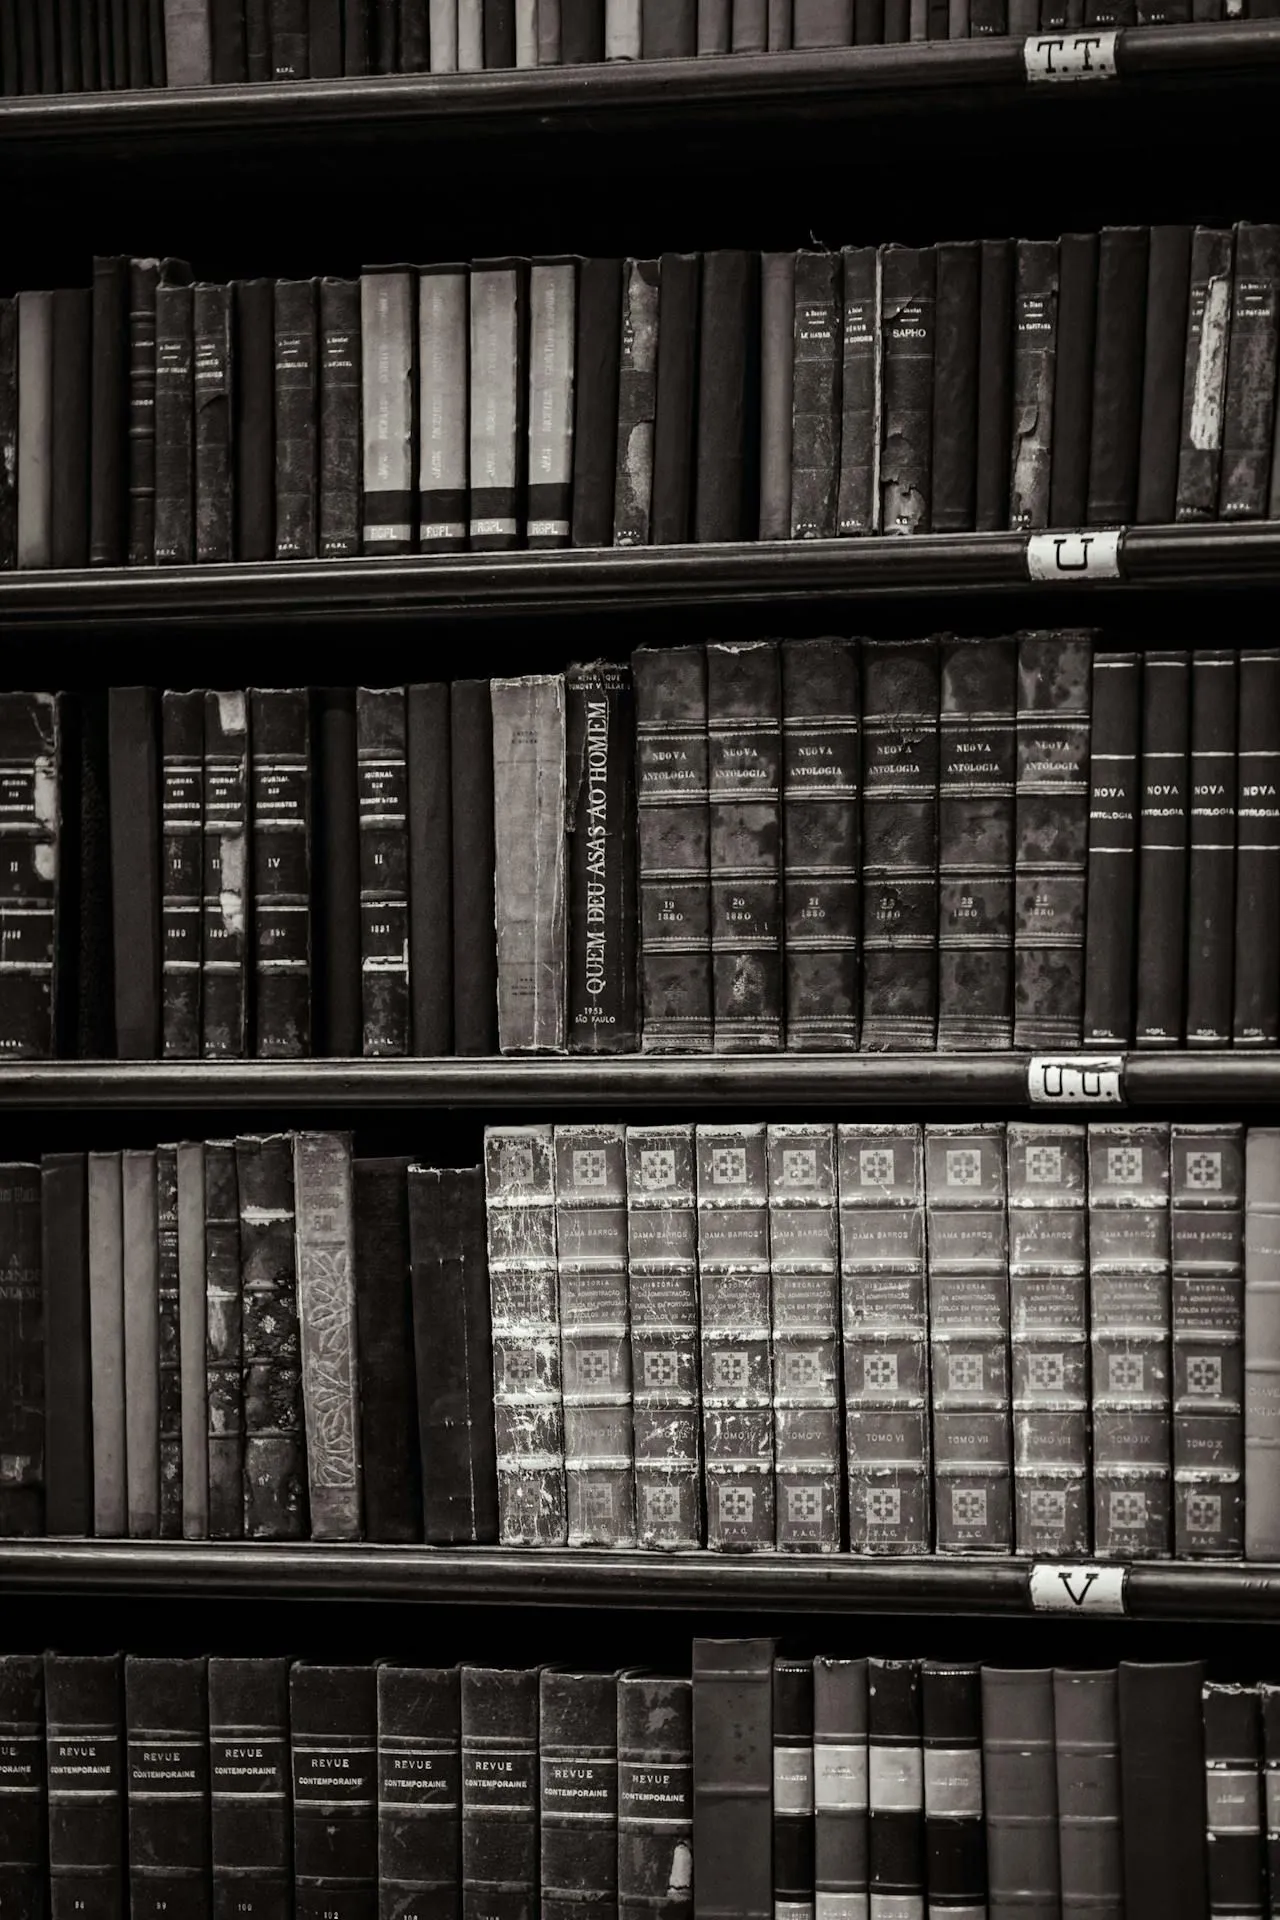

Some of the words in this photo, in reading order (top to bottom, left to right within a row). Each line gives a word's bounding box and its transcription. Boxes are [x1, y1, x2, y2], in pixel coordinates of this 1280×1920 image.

[1037, 38, 1106, 73] T.T.
[892, 328, 926, 338] SAPHO
[1054, 538, 1094, 570] U
[587, 701, 607, 783] HOMEM
[1034, 740, 1070, 751] NUOVA
[798, 747, 833, 756] NUOVA
[957, 743, 991, 753] NUOVA
[653, 751, 687, 761] NUOVA
[723, 749, 757, 758] NUOVA
[869, 765, 920, 775] ANTOLOGIA
[948, 763, 1000, 772] ANTOLOGIA
[1024, 761, 1079, 771] ANTOLOGIA
[643, 770, 695, 781] ANTOLOGIA
[715, 769, 767, 778] ANTOLOGIA
[790, 767, 842, 776] ANTOLOGIA
[1094, 788, 1125, 797] NOVA
[1147, 785, 1179, 795] NOVA
[1194, 785, 1225, 794] NOVA
[1243, 785, 1276, 796] NOVA
[586, 787, 607, 818] AO
[585, 824, 607, 877] ASAS
[267, 857, 281, 868] IV
[586, 880, 606, 925] DEU
[663, 901, 674, 909] 19
[732, 898, 745, 906] 20
[585, 931, 607, 995] QUEM
[591, 1016, 616, 1024] PAULO
[1041, 1064, 1112, 1097] U.U.
[866, 1434, 892, 1442] TOMO
[948, 1436, 973, 1444] TOMO
[975, 1436, 989, 1444] VII
[1186, 1440, 1212, 1449] TOMO
[1058, 1572, 1099, 1605] V
[60, 1747, 96, 1757] REVUE
[144, 1752, 181, 1761] REVUE
[225, 1749, 263, 1758] REVUE
[312, 1759, 350, 1768] REVUE
[394, 1760, 432, 1769] REVUE
[475, 1762, 513, 1771] REVUE
[50, 1766, 111, 1774] CONTEMPORAINE
[133, 1770, 196, 1778] CONTEMPORAINE
[215, 1767, 276, 1775] CONTEMPORAINE
[555, 1770, 593, 1779] REVUE
[299, 1777, 363, 1785] CONTEMPORAINE
[384, 1779, 447, 1788] CONTEMPORAINE
[632, 1775, 670, 1784] REVUE
[465, 1780, 528, 1789] CONTEMPORAINE
[544, 1788, 608, 1798] CONTEMPORAINE
[622, 1792, 685, 1802] CONTEMPORAINE
[324, 1911, 339, 1920] 102
